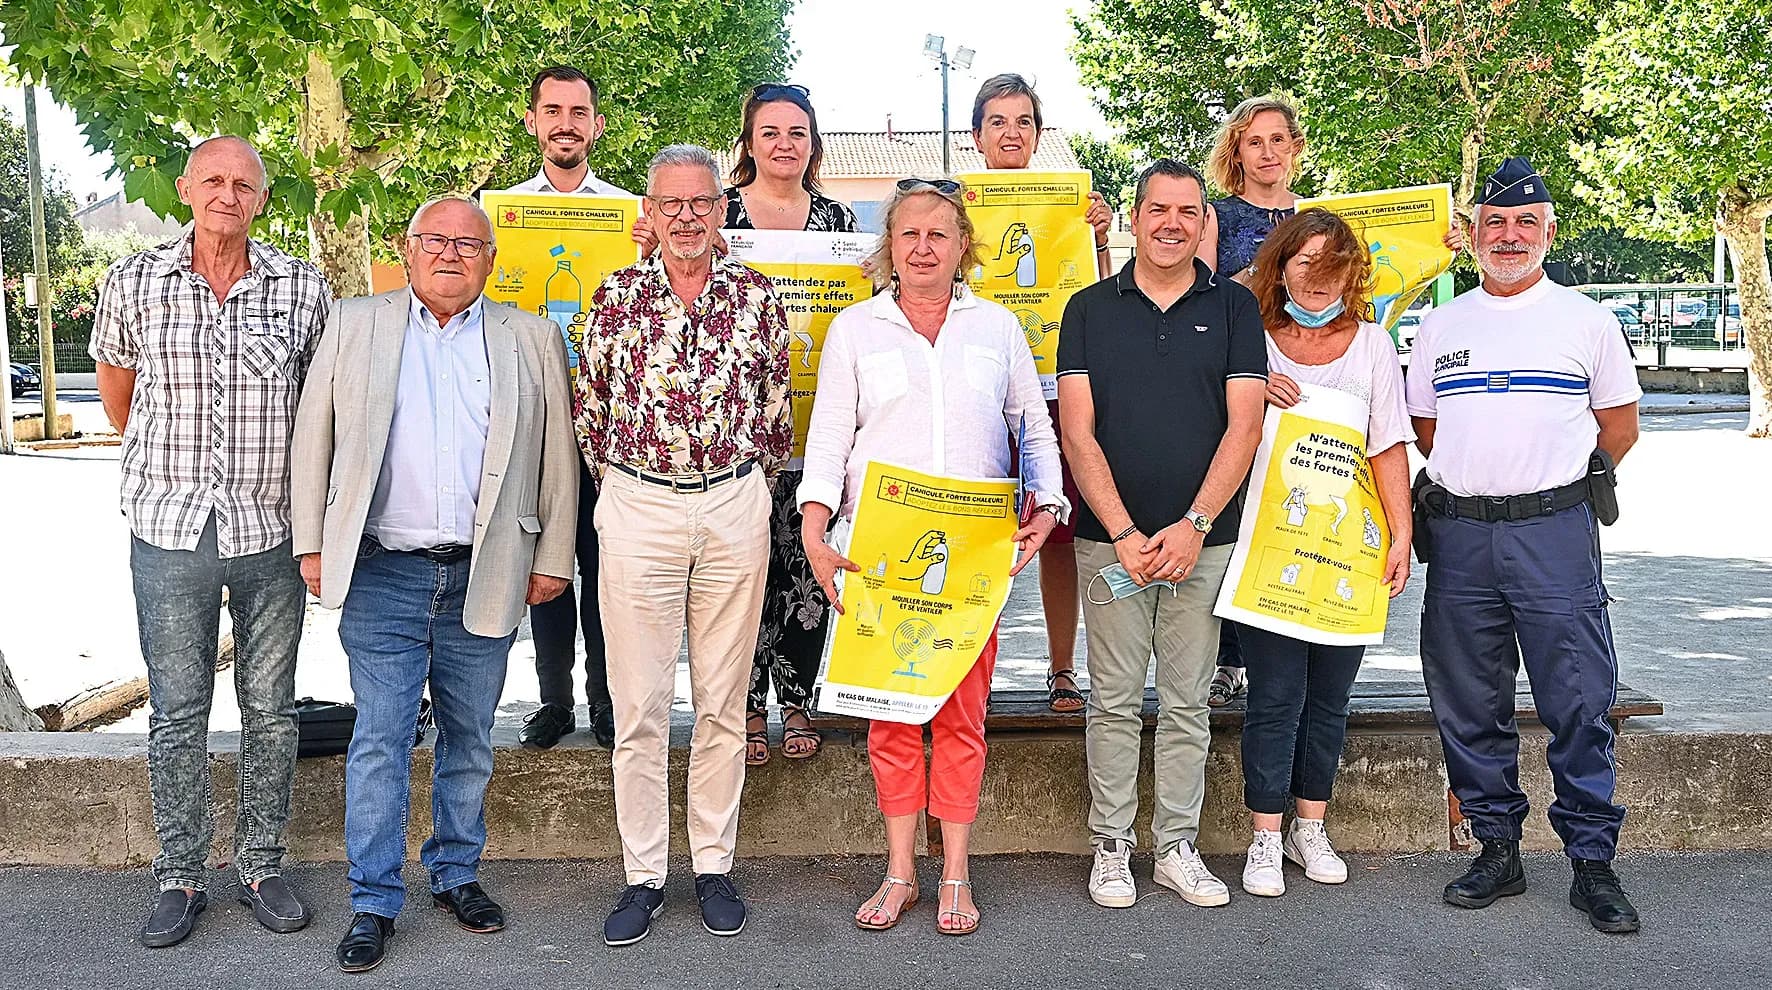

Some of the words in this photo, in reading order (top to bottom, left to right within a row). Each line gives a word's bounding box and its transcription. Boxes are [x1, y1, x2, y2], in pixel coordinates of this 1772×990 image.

[828, 280, 846, 289] pas
[780, 290, 820, 300] remiers
[824, 291, 854, 301] effets
[786, 304, 807, 312] rtes
[810, 303, 846, 313] chaleu
[1436, 350, 1470, 368] POLICE
[1296, 442, 1312, 454] les
[1290, 456, 1311, 468] des
[1314, 461, 1349, 477] fortes
[910, 487, 944, 499] CANICULE,
[946, 493, 971, 502] FORTES
[1294, 548, 1352, 572] Protégez-vous
[892, 595, 921, 605] MOUILLER
[917, 607, 942, 615] VENTILER
